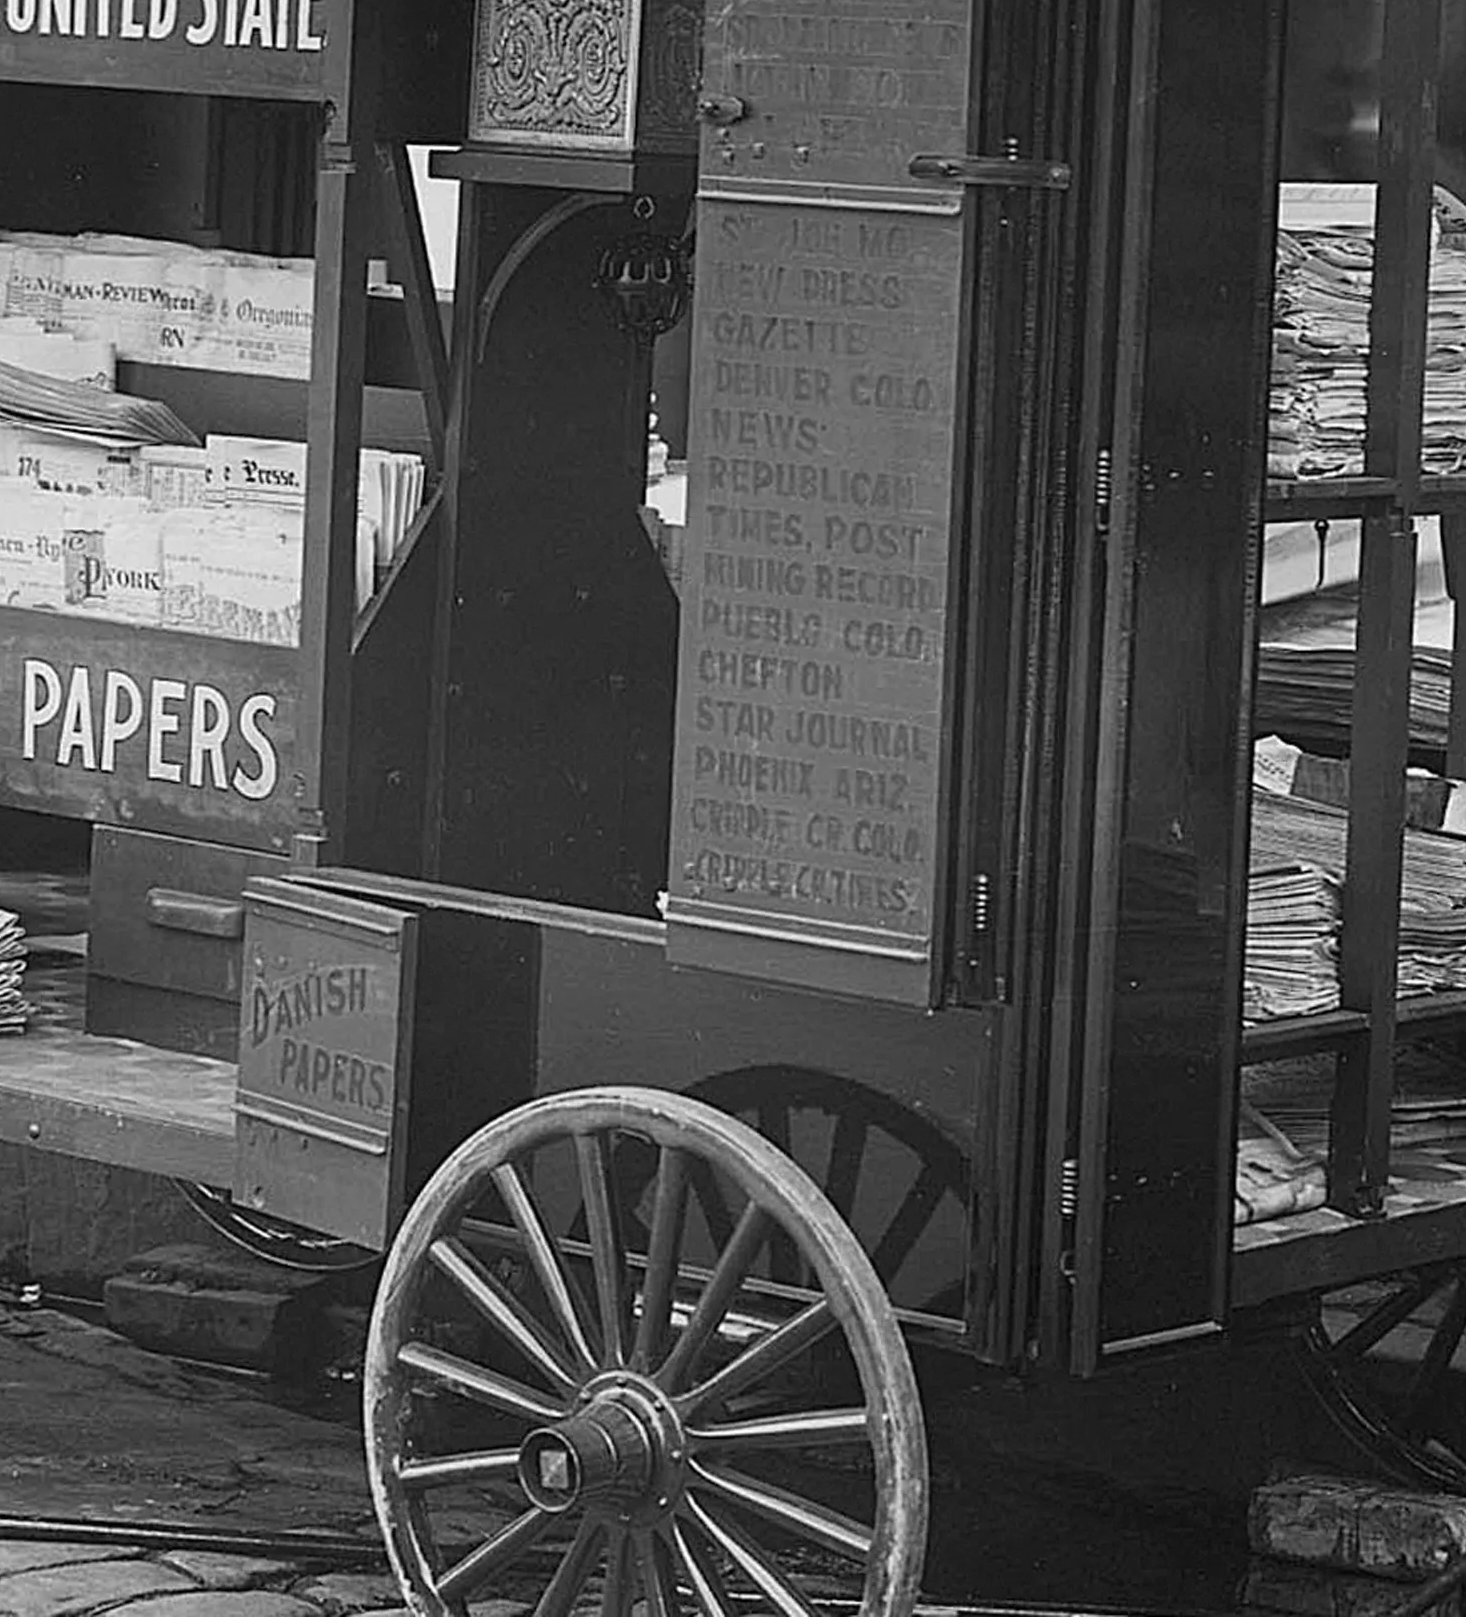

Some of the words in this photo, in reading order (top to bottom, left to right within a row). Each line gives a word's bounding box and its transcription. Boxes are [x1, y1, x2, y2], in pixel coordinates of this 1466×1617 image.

[800, 268, 903, 310] PRESS
[710, 312, 870, 356] GAZETTE
[713, 358, 832, 406] DENVER
[706, 454, 917, 511] REPUBLICAN
[823, 515, 928, 561] POST
[703, 551, 806, 597] MINING
[813, 564, 937, 613] RECORD
[701, 597, 822, 647] PUEBLO
[22, 658, 278, 802] PAPERS
[694, 696, 775, 744] STAR
[785, 710, 929, 764] JOURNAL
[694, 744, 816, 799] PHOENIX
[250, 966, 368, 1050] DANISH
[280, 1037, 385, 1110] PAPERS
